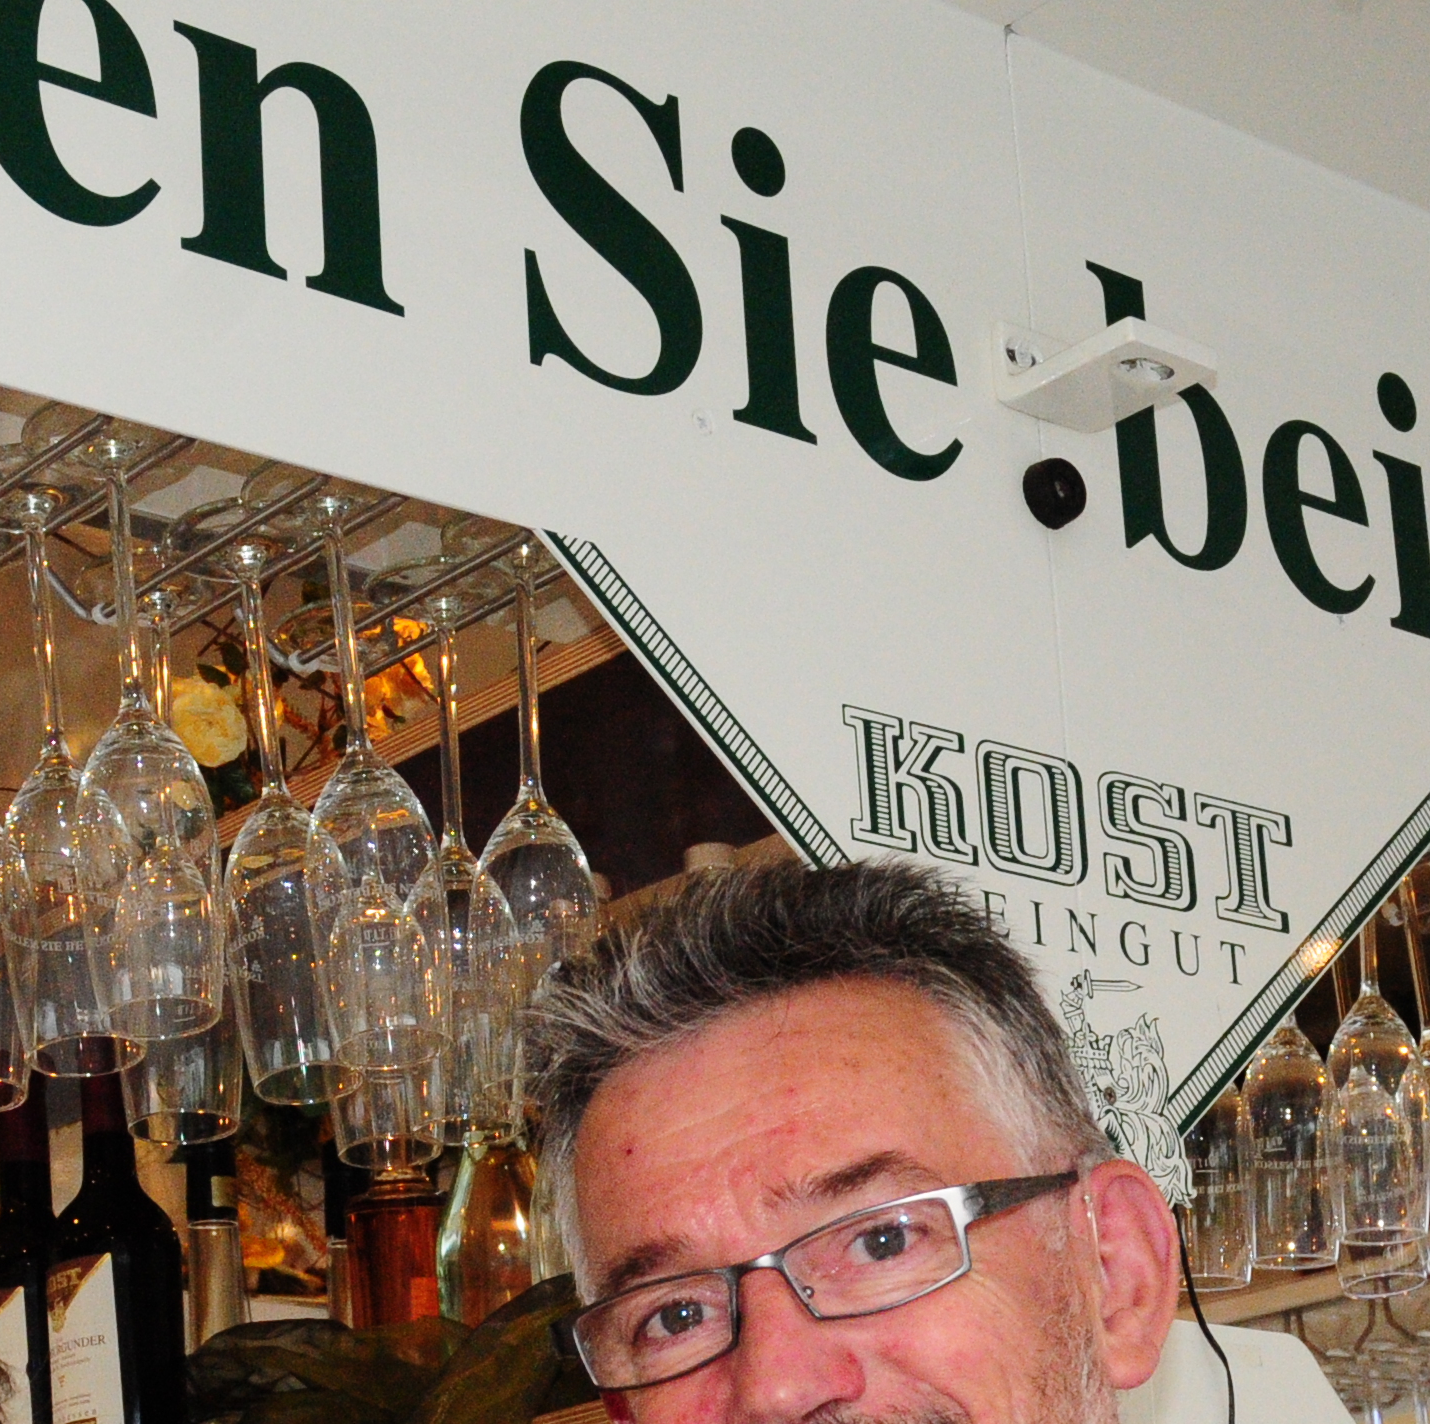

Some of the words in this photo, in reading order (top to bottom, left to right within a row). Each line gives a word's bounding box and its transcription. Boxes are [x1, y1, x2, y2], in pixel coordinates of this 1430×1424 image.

[519, 59, 964, 482] Sie
[842, 703, 1293, 933] KOST
[943, 884, 1246, 986] EINGUT
